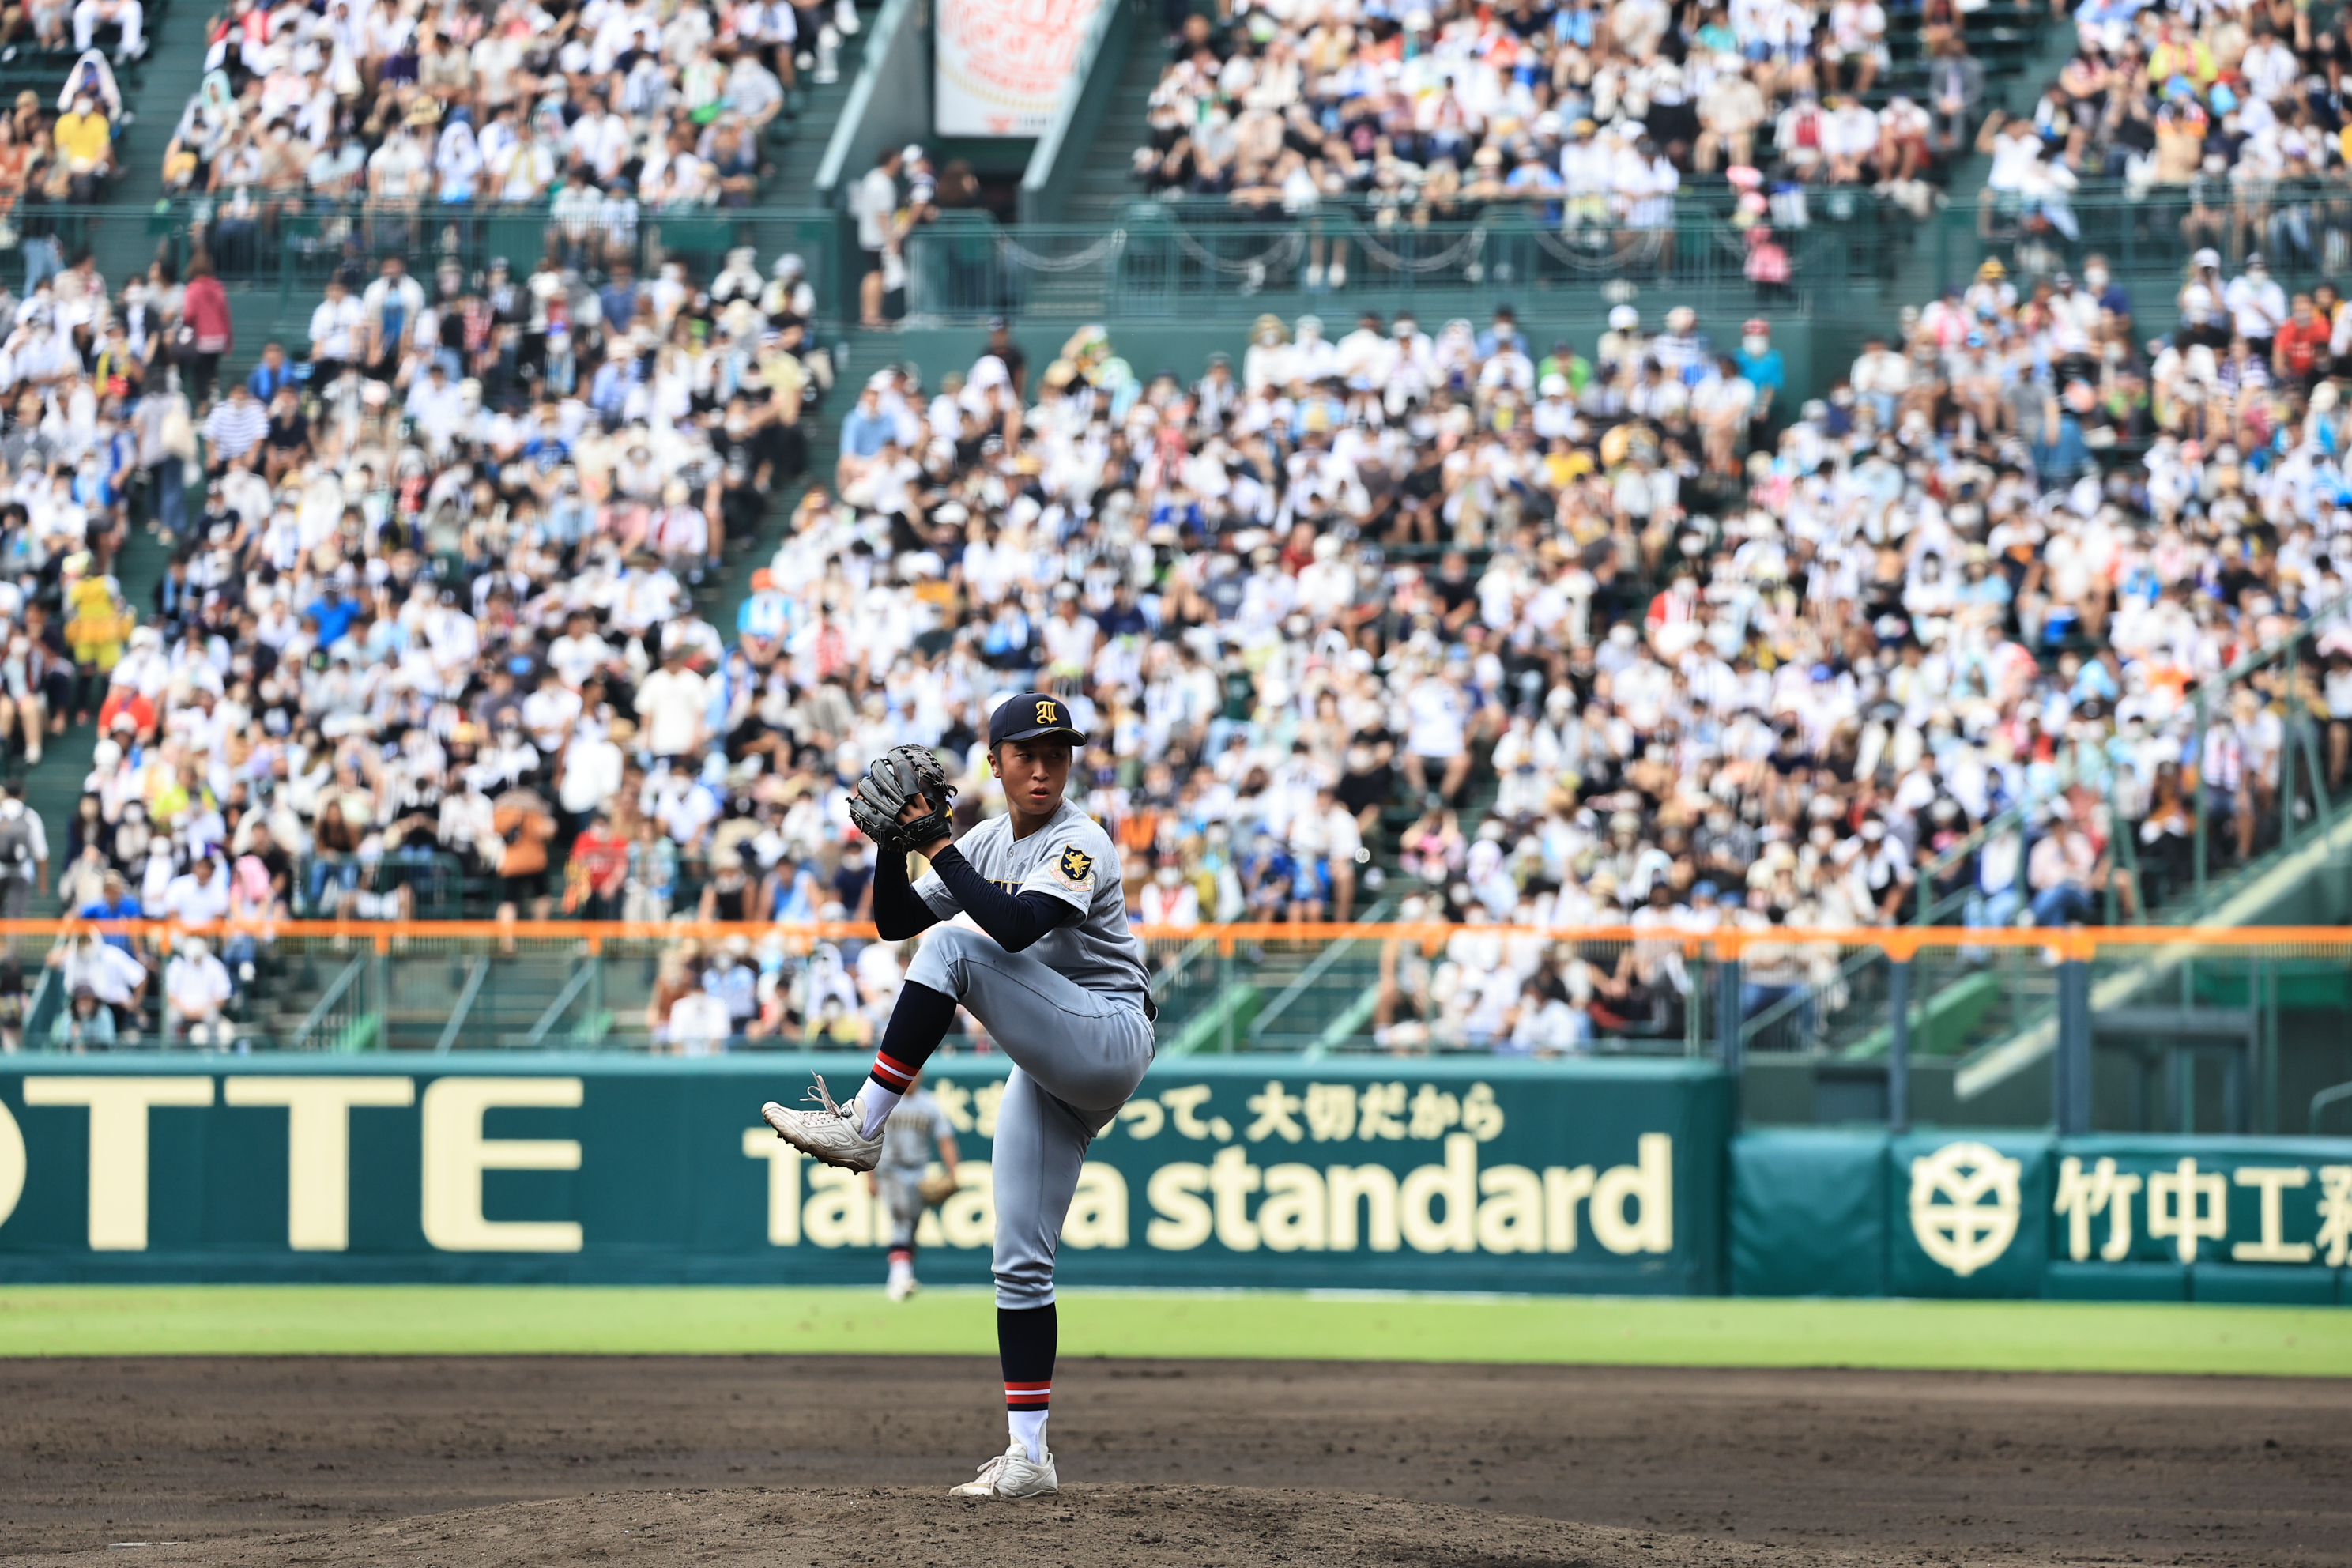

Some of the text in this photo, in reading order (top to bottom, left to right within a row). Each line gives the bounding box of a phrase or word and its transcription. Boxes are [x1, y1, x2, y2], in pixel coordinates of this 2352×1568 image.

[0, 1076, 584, 1252] TTE
[931, 1078, 1505, 1143] 水まって、大切だから
[742, 1127, 1674, 1254] Taaa standard
